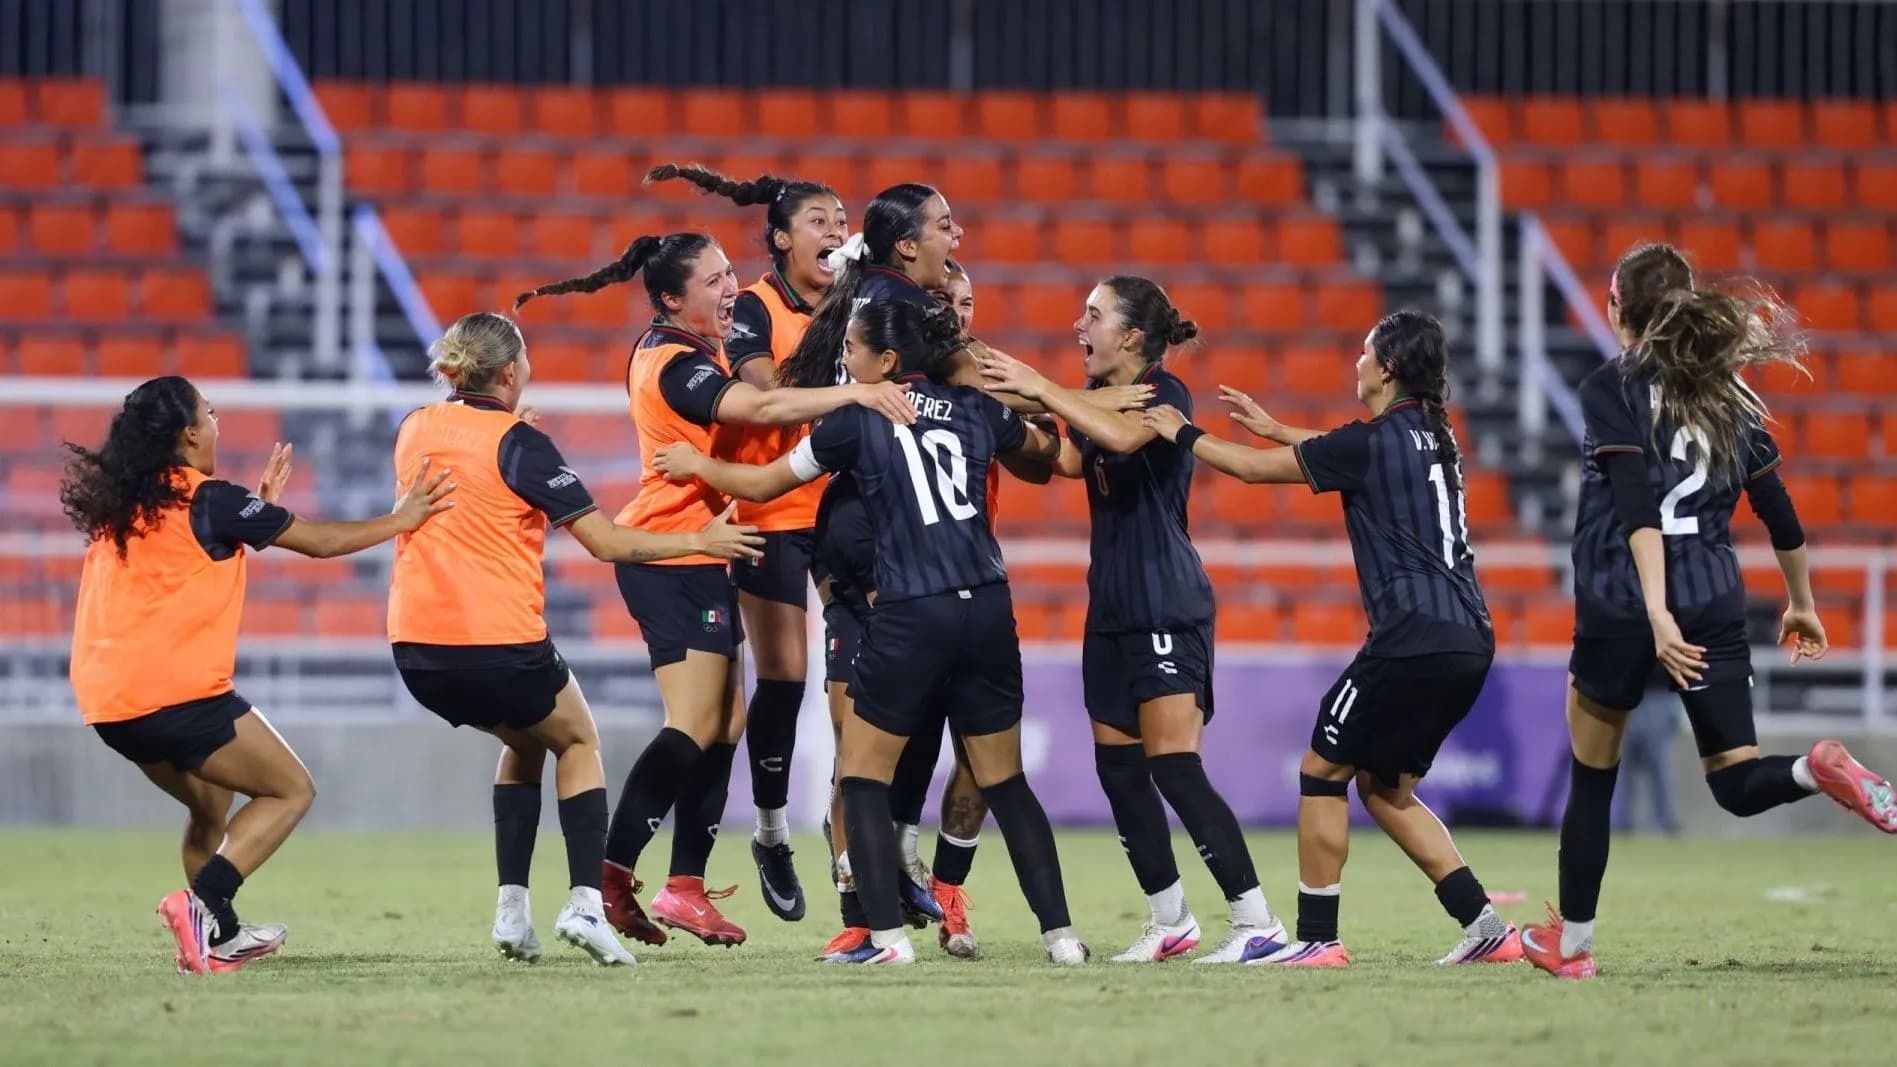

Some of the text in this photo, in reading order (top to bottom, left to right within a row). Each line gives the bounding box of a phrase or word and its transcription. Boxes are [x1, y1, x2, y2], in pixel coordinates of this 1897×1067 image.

[893, 423, 978, 526] 10
[1659, 423, 1711, 536] 2
[1330, 678, 1358, 725] 11
